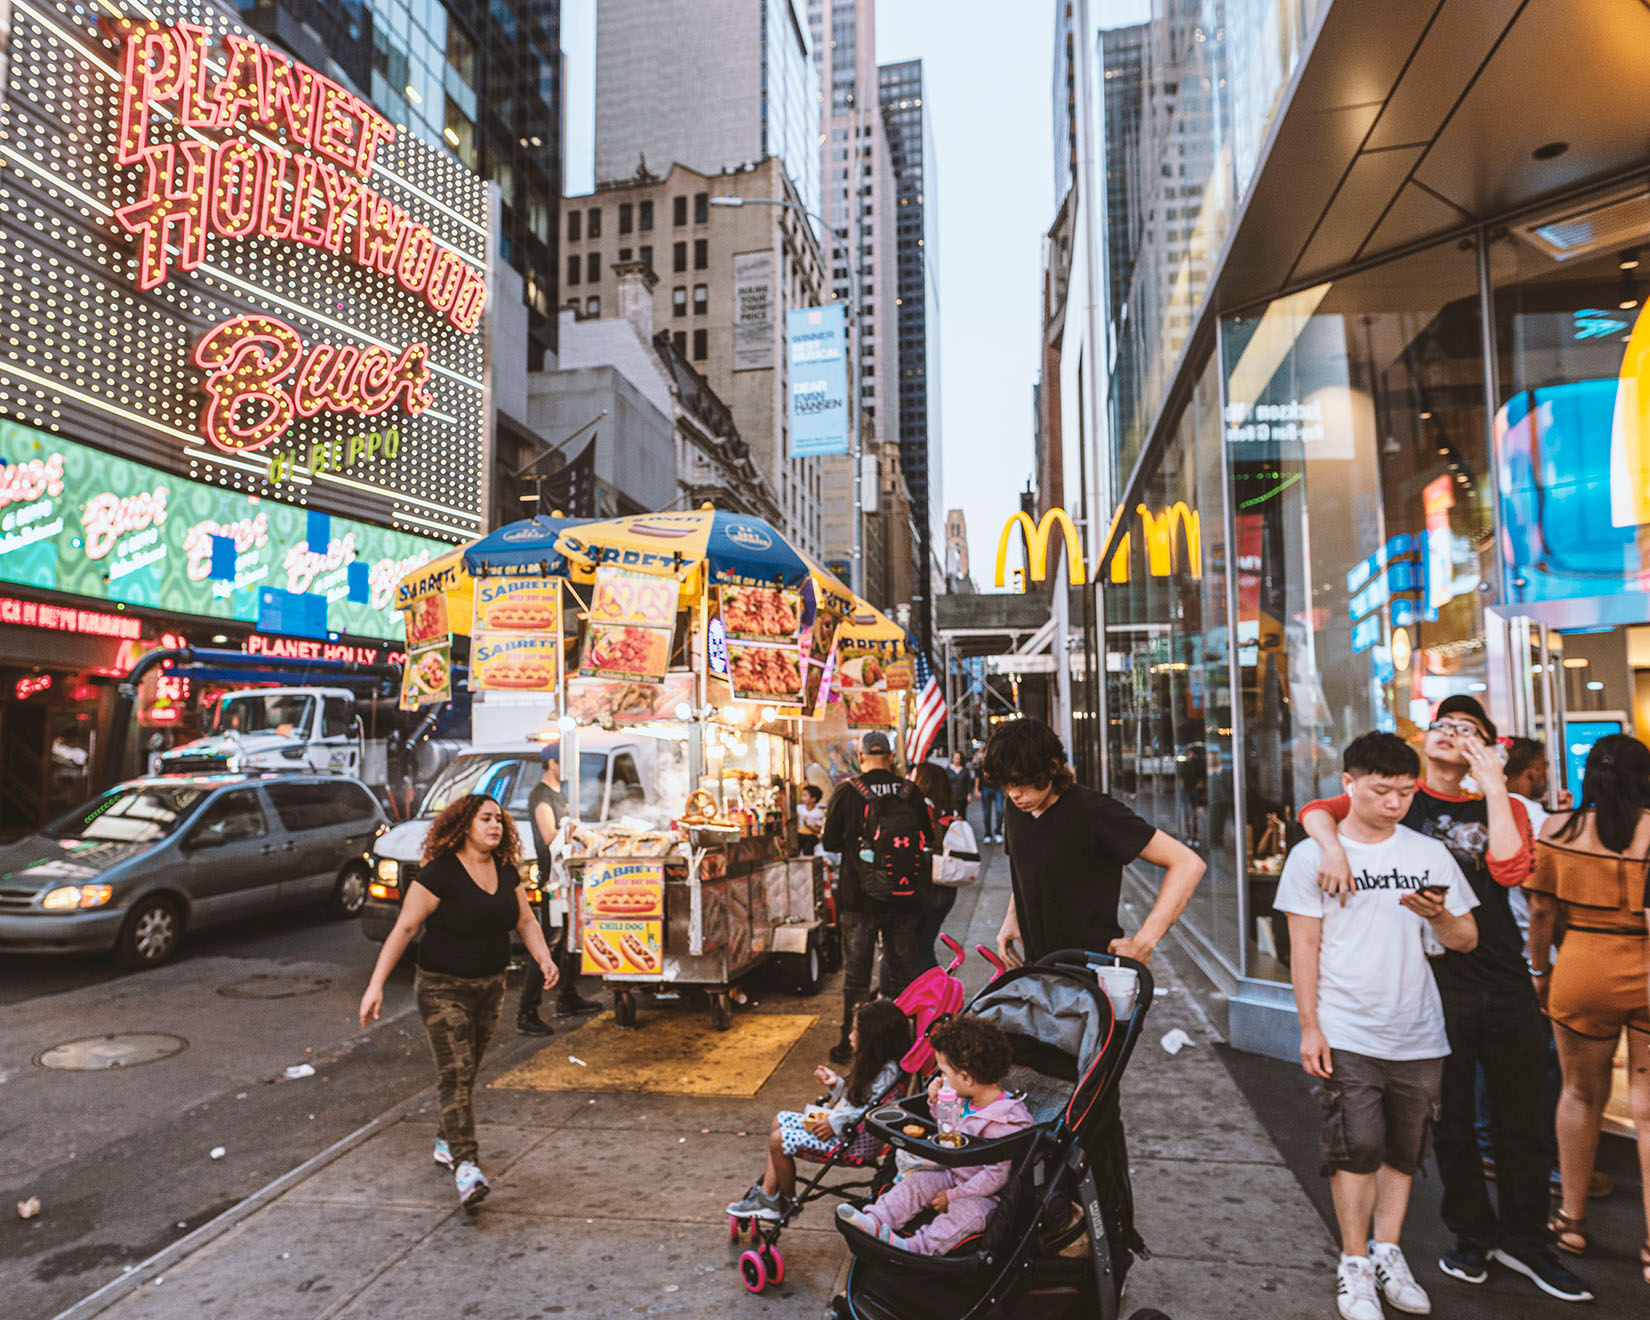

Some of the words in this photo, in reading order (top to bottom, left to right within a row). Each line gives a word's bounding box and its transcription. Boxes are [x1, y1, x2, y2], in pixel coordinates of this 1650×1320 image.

[118, 21, 397, 178] PLANET
[115, 139, 488, 335] HOLLYWOOD
[794, 399, 843, 412] HANSEN
[311, 428, 401, 476] BEPPO
[480, 580, 558, 603] SABRETT
[247, 634, 322, 661] PLANET
[476, 639, 557, 662] SABRETT
[589, 865, 662, 888] SABRETT
[625, 922, 645, 931] DOG
